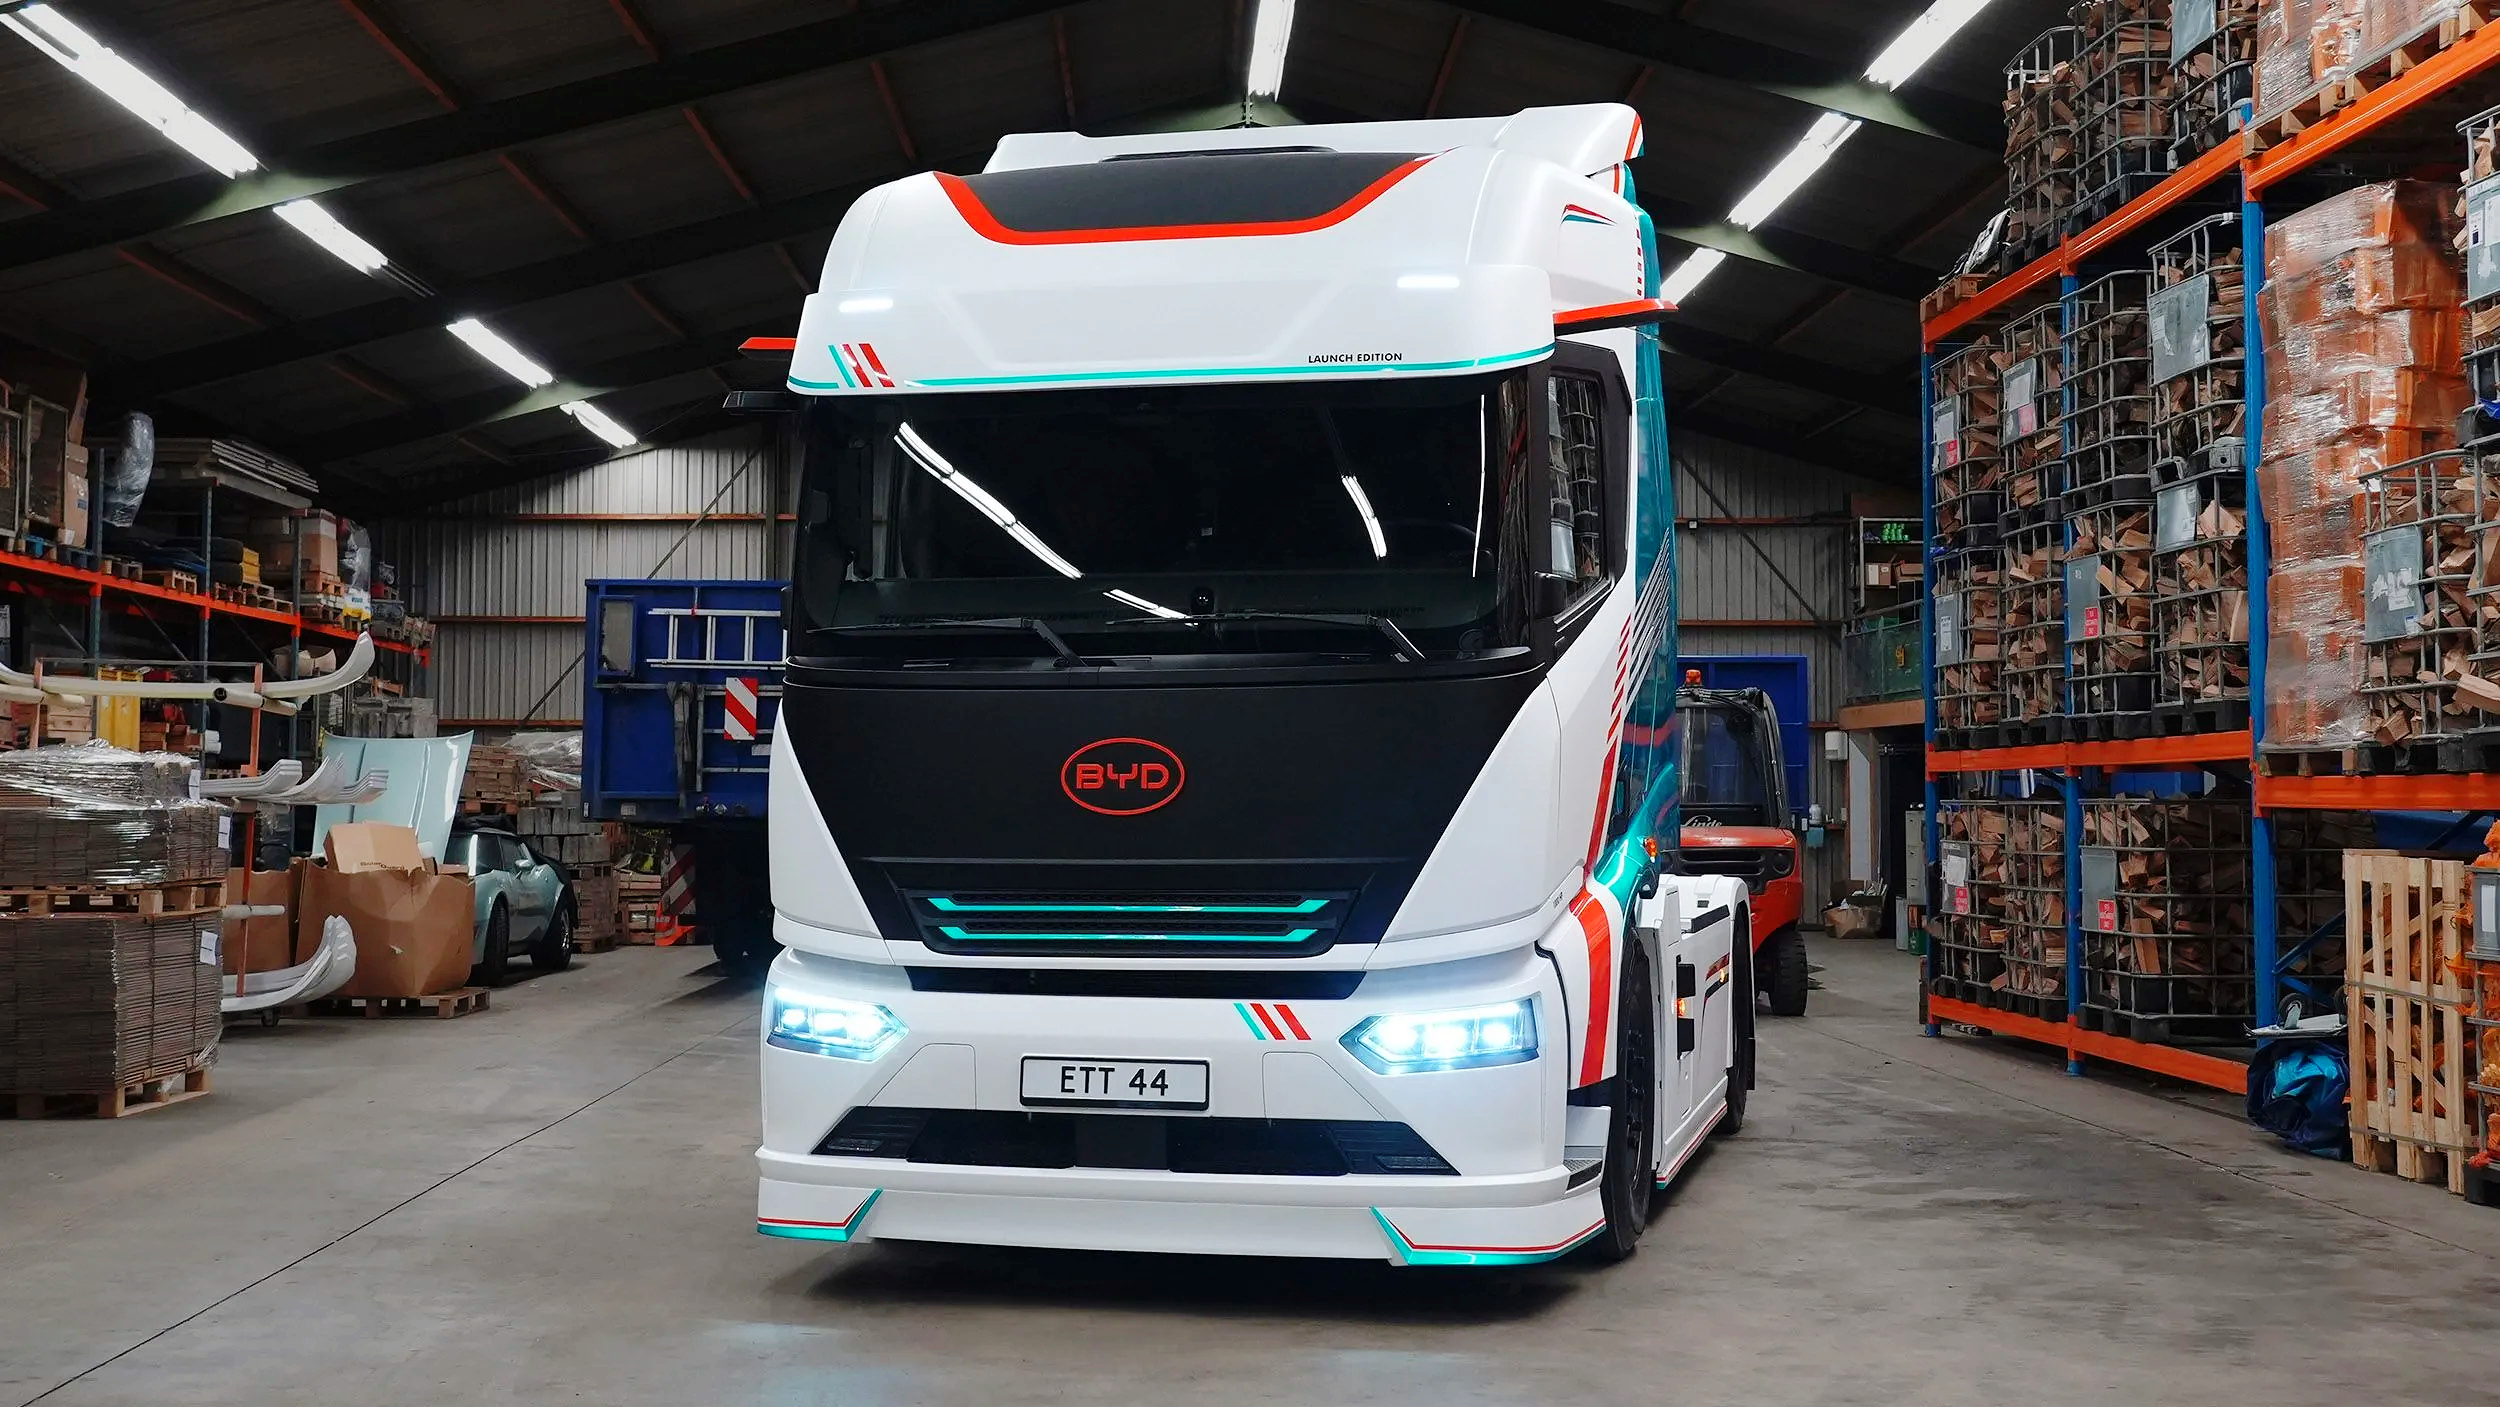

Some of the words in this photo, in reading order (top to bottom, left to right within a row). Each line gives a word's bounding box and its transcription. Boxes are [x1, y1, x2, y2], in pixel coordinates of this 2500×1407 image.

[1308, 354, 1353, 363] LAUNCH
[1357, 352, 1402, 362] EDITION
[1076, 763, 1170, 789] BYD
[1060, 1065, 1115, 1094] ETT
[1128, 1068, 1169, 1096] 44
